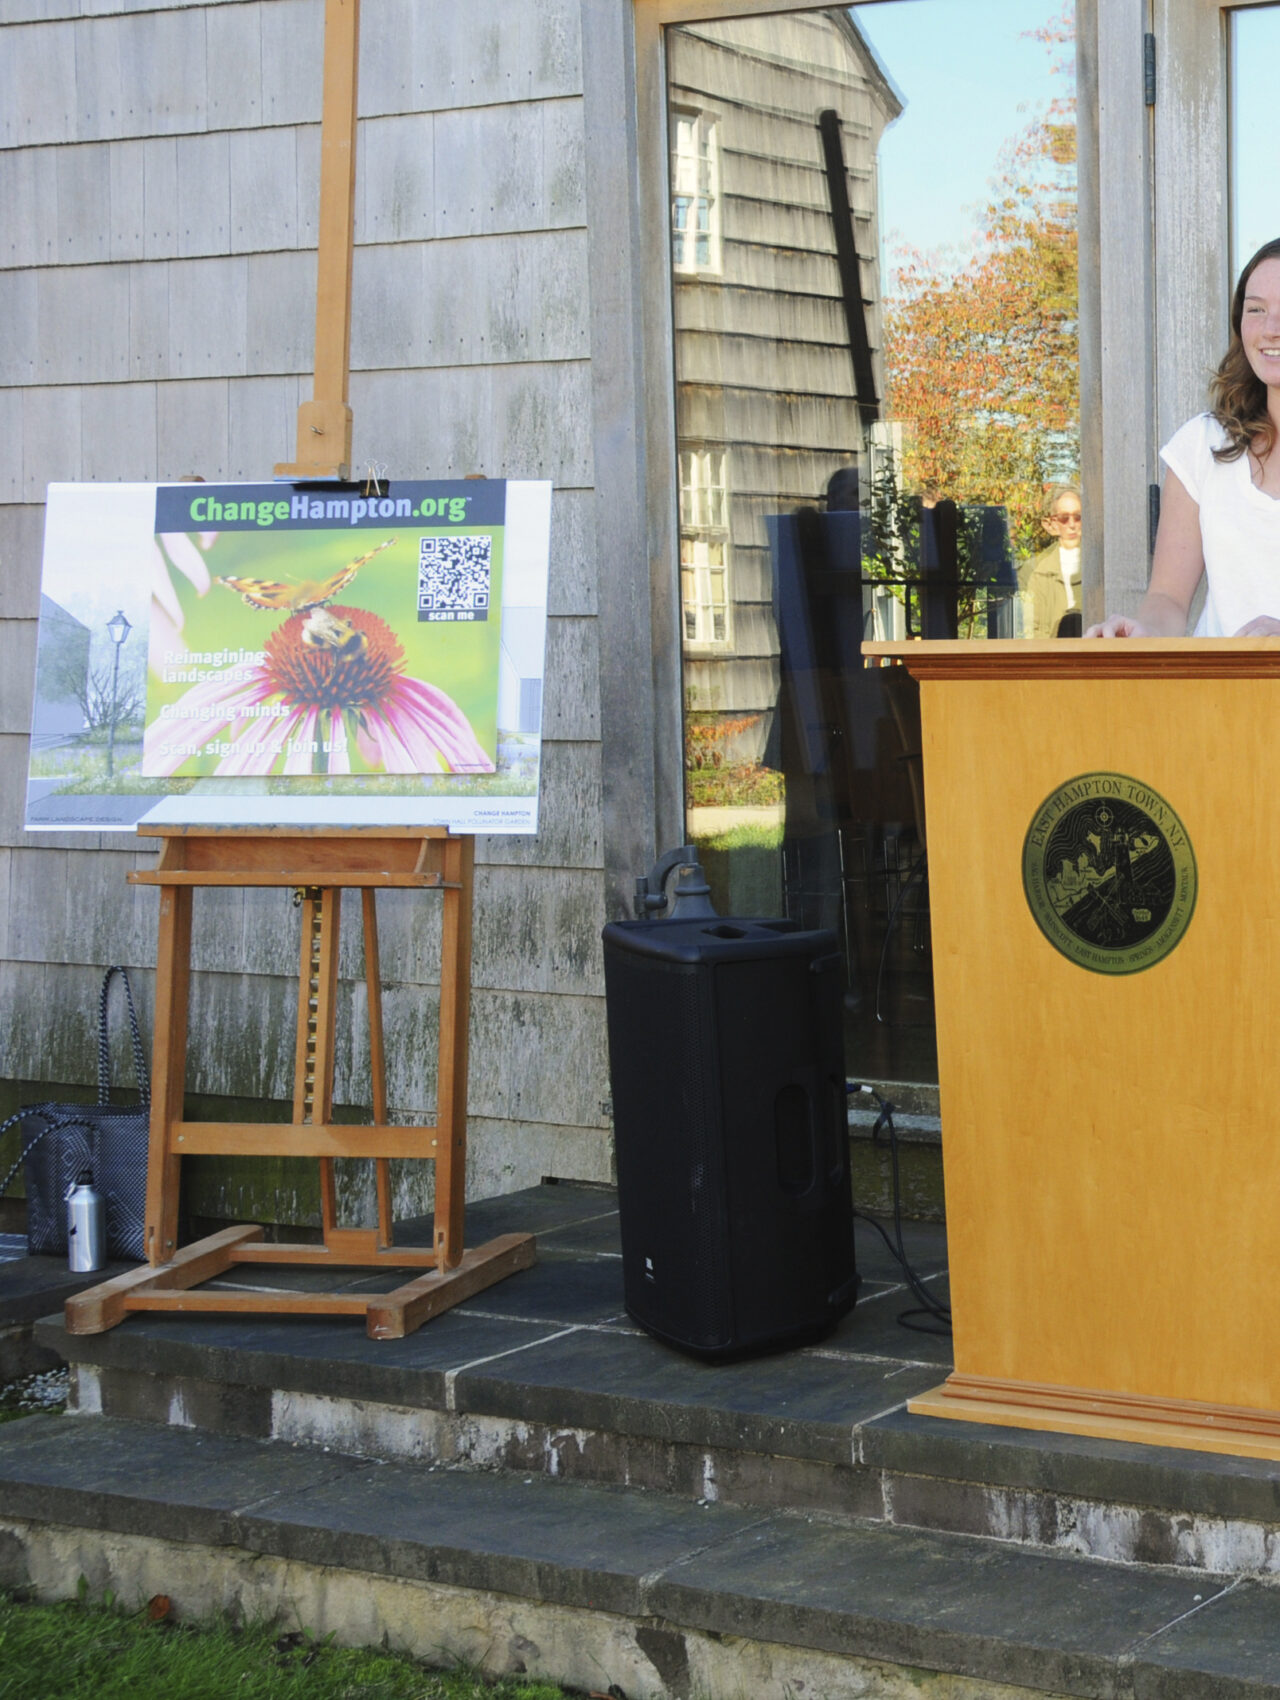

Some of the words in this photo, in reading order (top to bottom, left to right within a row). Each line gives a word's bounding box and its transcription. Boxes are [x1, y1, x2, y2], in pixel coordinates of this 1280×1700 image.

[189, 496, 466, 526] ChangeHampton.org
[428, 611, 455, 621] scan
[457, 611, 475, 620] me
[164, 648, 266, 667] Reimagining
[162, 668, 253, 684] landscapes
[160, 702, 240, 722] Changing
[241, 702, 290, 717] minds
[160, 741, 202, 757] Scan,
[205, 739, 240, 757] sign
[244, 742, 265, 757] up
[270, 741, 282, 753] &
[285, 738, 318, 755] join
[323, 738, 348, 753] us!
[1055, 780, 1122, 812] HAMPTON
